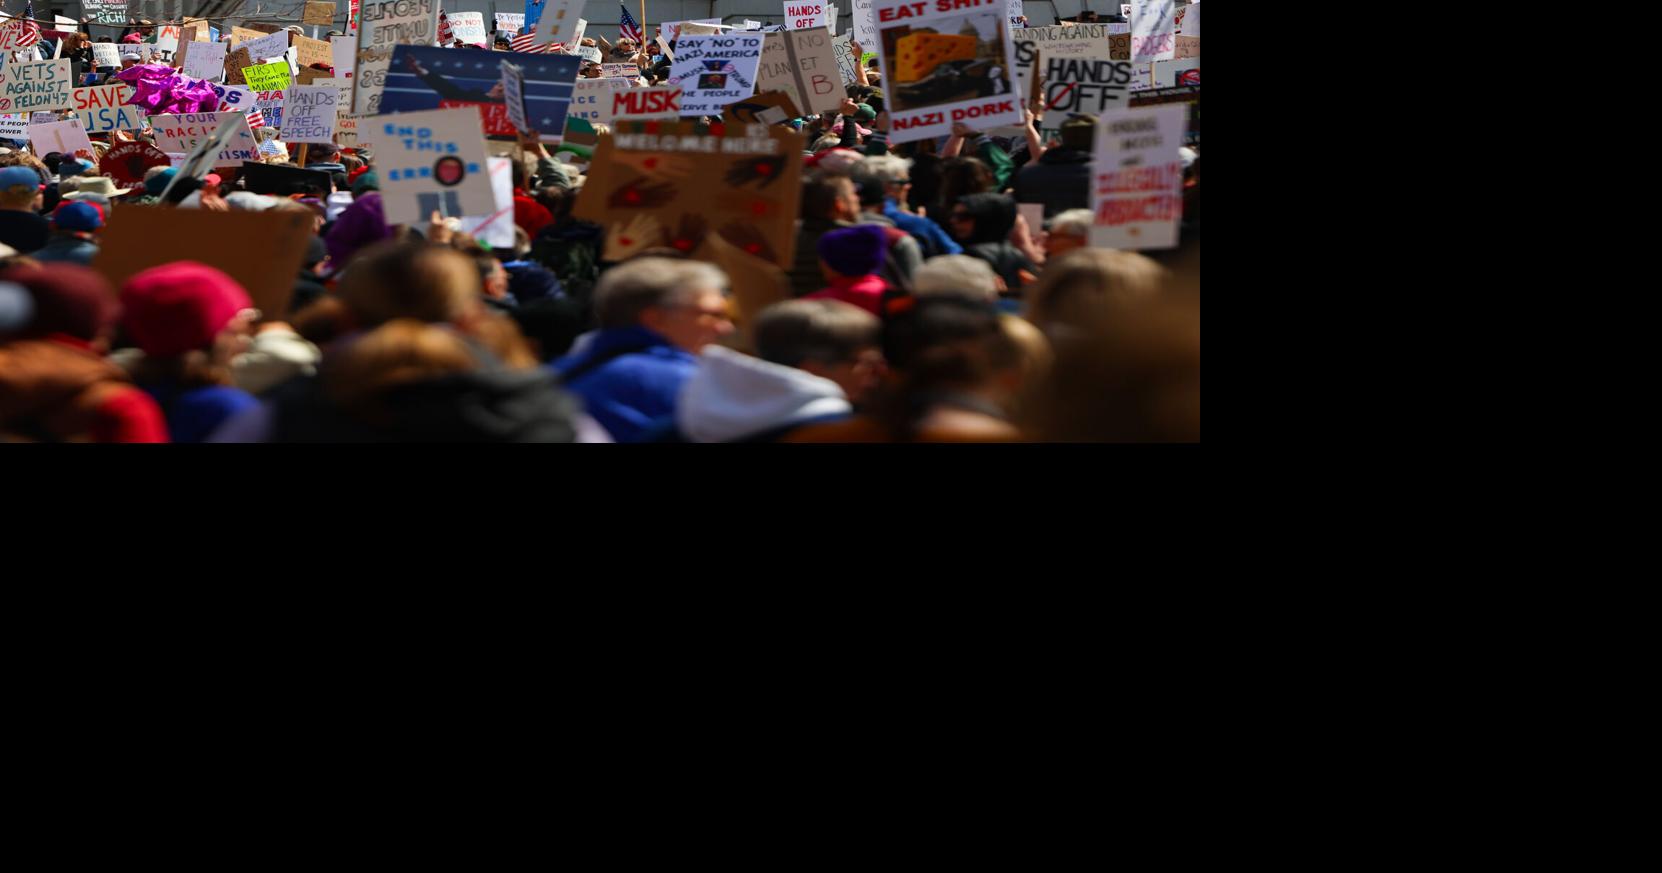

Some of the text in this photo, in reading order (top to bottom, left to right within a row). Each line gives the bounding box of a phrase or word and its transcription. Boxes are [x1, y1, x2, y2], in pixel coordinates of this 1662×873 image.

[96, 10, 126, 24] RICH!
[788, 5, 821, 16] HANDS
[879, 2, 928, 22] EAT
[936, 0, 996, 12] SH
[796, 18, 815, 28] OFF
[1012, 28, 1057, 41] ANDING
[1060, 24, 1106, 39] AGAINST
[677, 40, 704, 48] SAY
[742, 39, 760, 47] TO
[799, 34, 825, 49] NO
[674, 49, 760, 63] NAZI AMERICA
[11, 63, 56, 81] VETS
[245, 62, 277, 76] FIRST
[1047, 58, 1131, 84] HANDS
[6, 80, 68, 95] AGAINST
[811, 75, 834, 94] B
[14, 92, 69, 109] FELON 47
[73, 86, 129, 110] SAVE
[289, 89, 335, 106] HANDS
[612, 89, 682, 116] MUSK
[1046, 81, 1126, 112] OFF
[291, 105, 316, 117] OFF
[892, 100, 1015, 131] NAZI DORK
[174, 113, 217, 125] YOUR
[287, 116, 320, 127] FREE
[281, 126, 332, 139] SPEECH
[383, 123, 432, 138] END
[403, 138, 458, 153] THIS
[613, 135, 780, 153] WELCOME HERE
[108, 145, 164, 160] HANDS OFF
